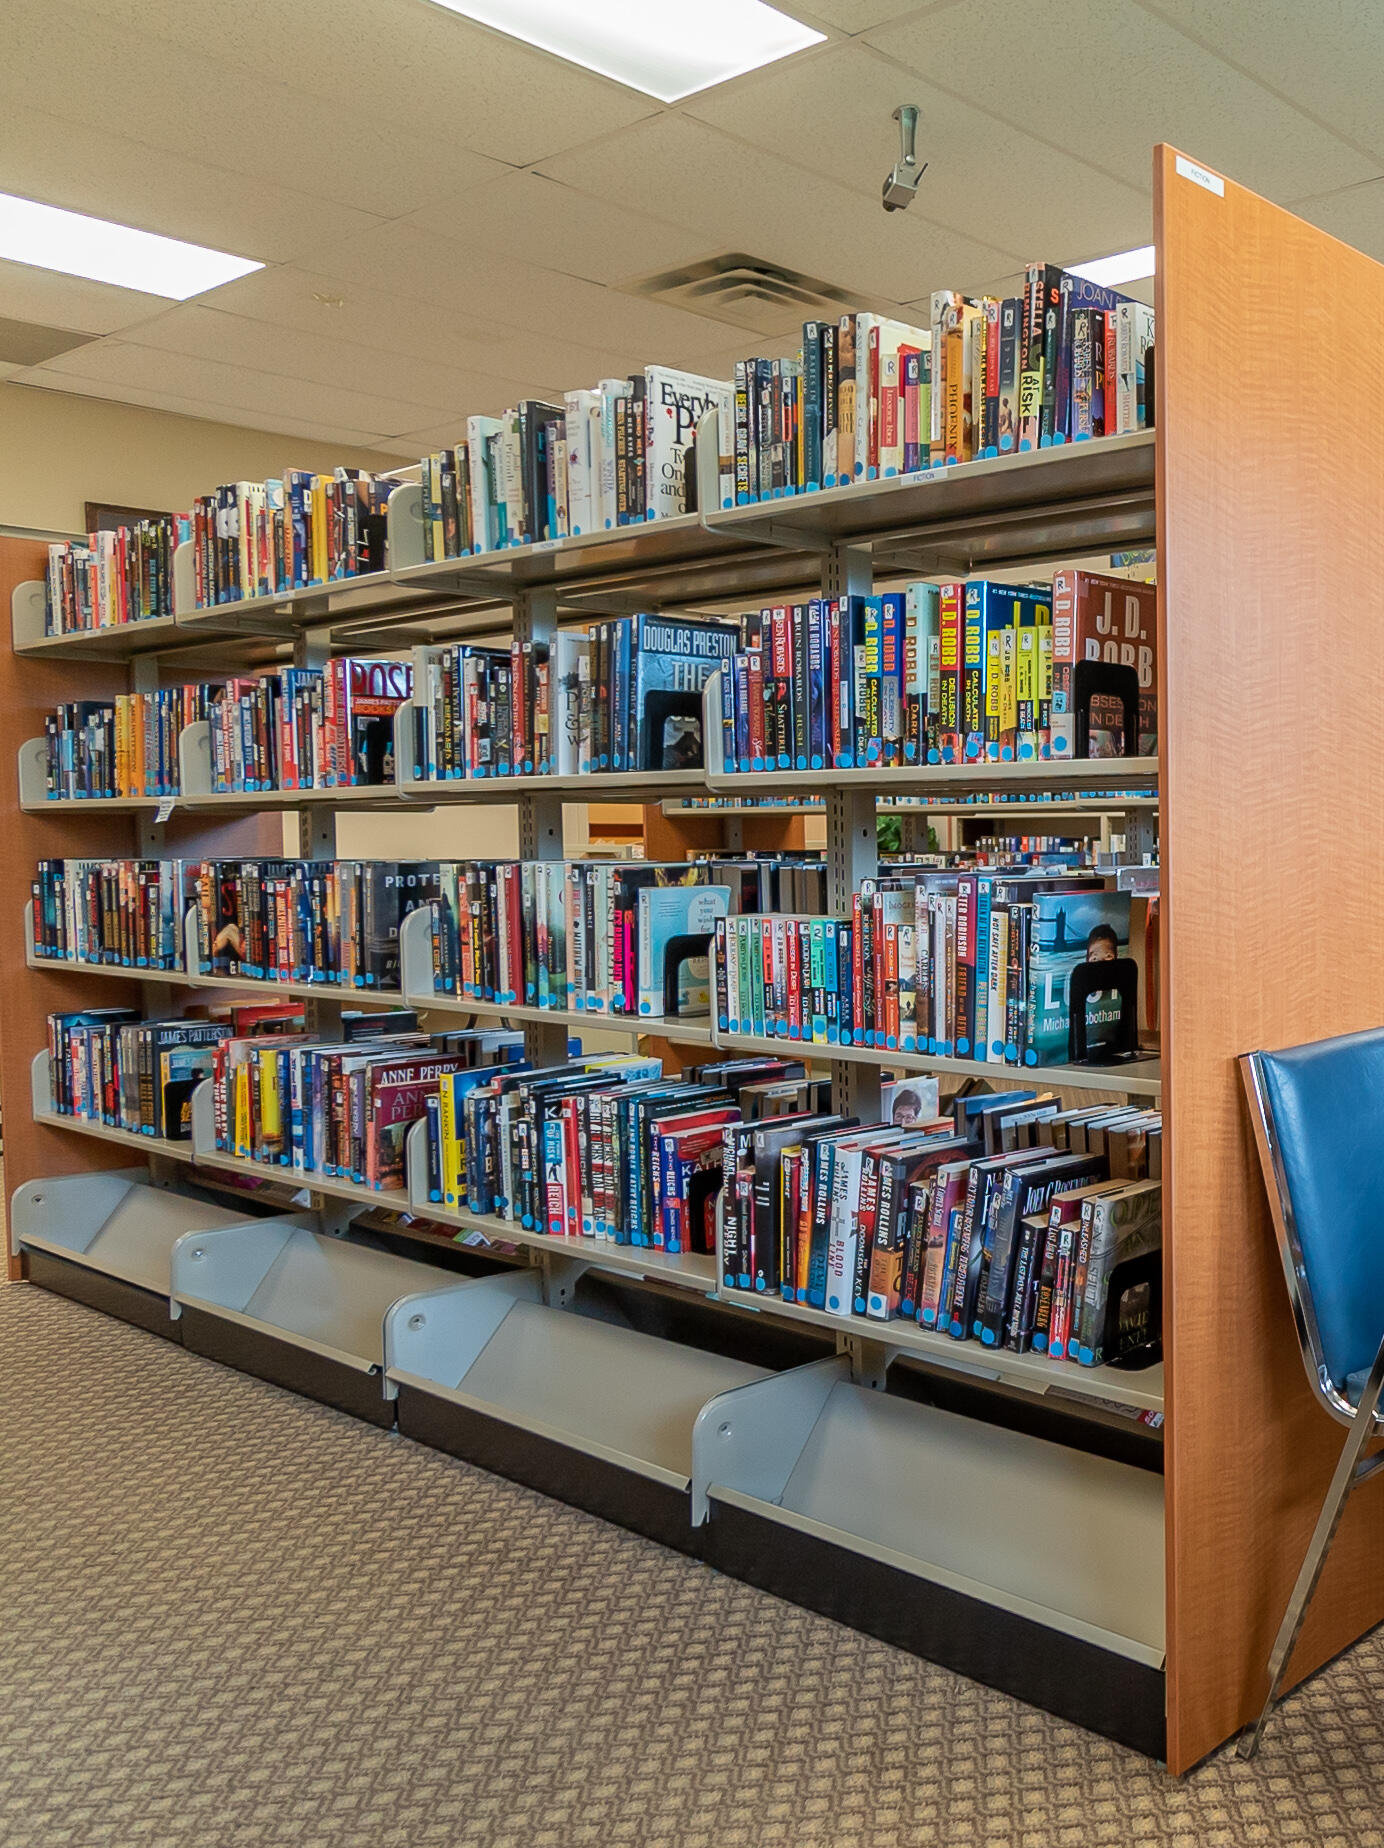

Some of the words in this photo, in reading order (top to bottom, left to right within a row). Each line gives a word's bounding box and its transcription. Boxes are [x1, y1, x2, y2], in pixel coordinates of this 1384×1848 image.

[1032, 281, 1044, 337] STELLA
[1077, 281, 1114, 309] JOAN
[1021, 375, 1033, 414] RISK
[949, 384, 958, 450] PHOENIX
[736, 456, 748, 491] SECRETS
[941, 612, 956, 625] D.
[1096, 591, 1119, 636] J.
[1125, 595, 1147, 639] D.
[644, 625, 691, 651] DOUGLAS
[693, 630, 737, 656] PRESTON
[776, 637, 786, 673] ROBARDS
[866, 638, 878, 673] ROBB
[942, 628, 957, 666] ROBB
[966, 626, 980, 664] ROBB
[1055, 617, 1071, 657] ROBB
[672, 661, 709, 691] THE
[990, 685, 998, 712] ROBB
[911, 704, 919, 735] DARK
[385, 874, 440, 887] PROTE
[958, 916, 967, 957] ROBINSON
[381, 1068, 413, 1085] ANNE
[548, 1185, 562, 1214] REICH
[816, 1184, 828, 1225] ROLLINS
[859, 1168, 868, 1212] ROLLINS
[867, 1174, 877, 1212] JAMES
[877, 1203, 890, 1246] ROLLINS
[835, 1240, 845, 1277] BLOOD
[856, 1224, 866, 1276] DOOMSDAY
[855, 1278, 863, 1298] KEY
[1037, 1286, 1051, 1328] ROSENBERG
